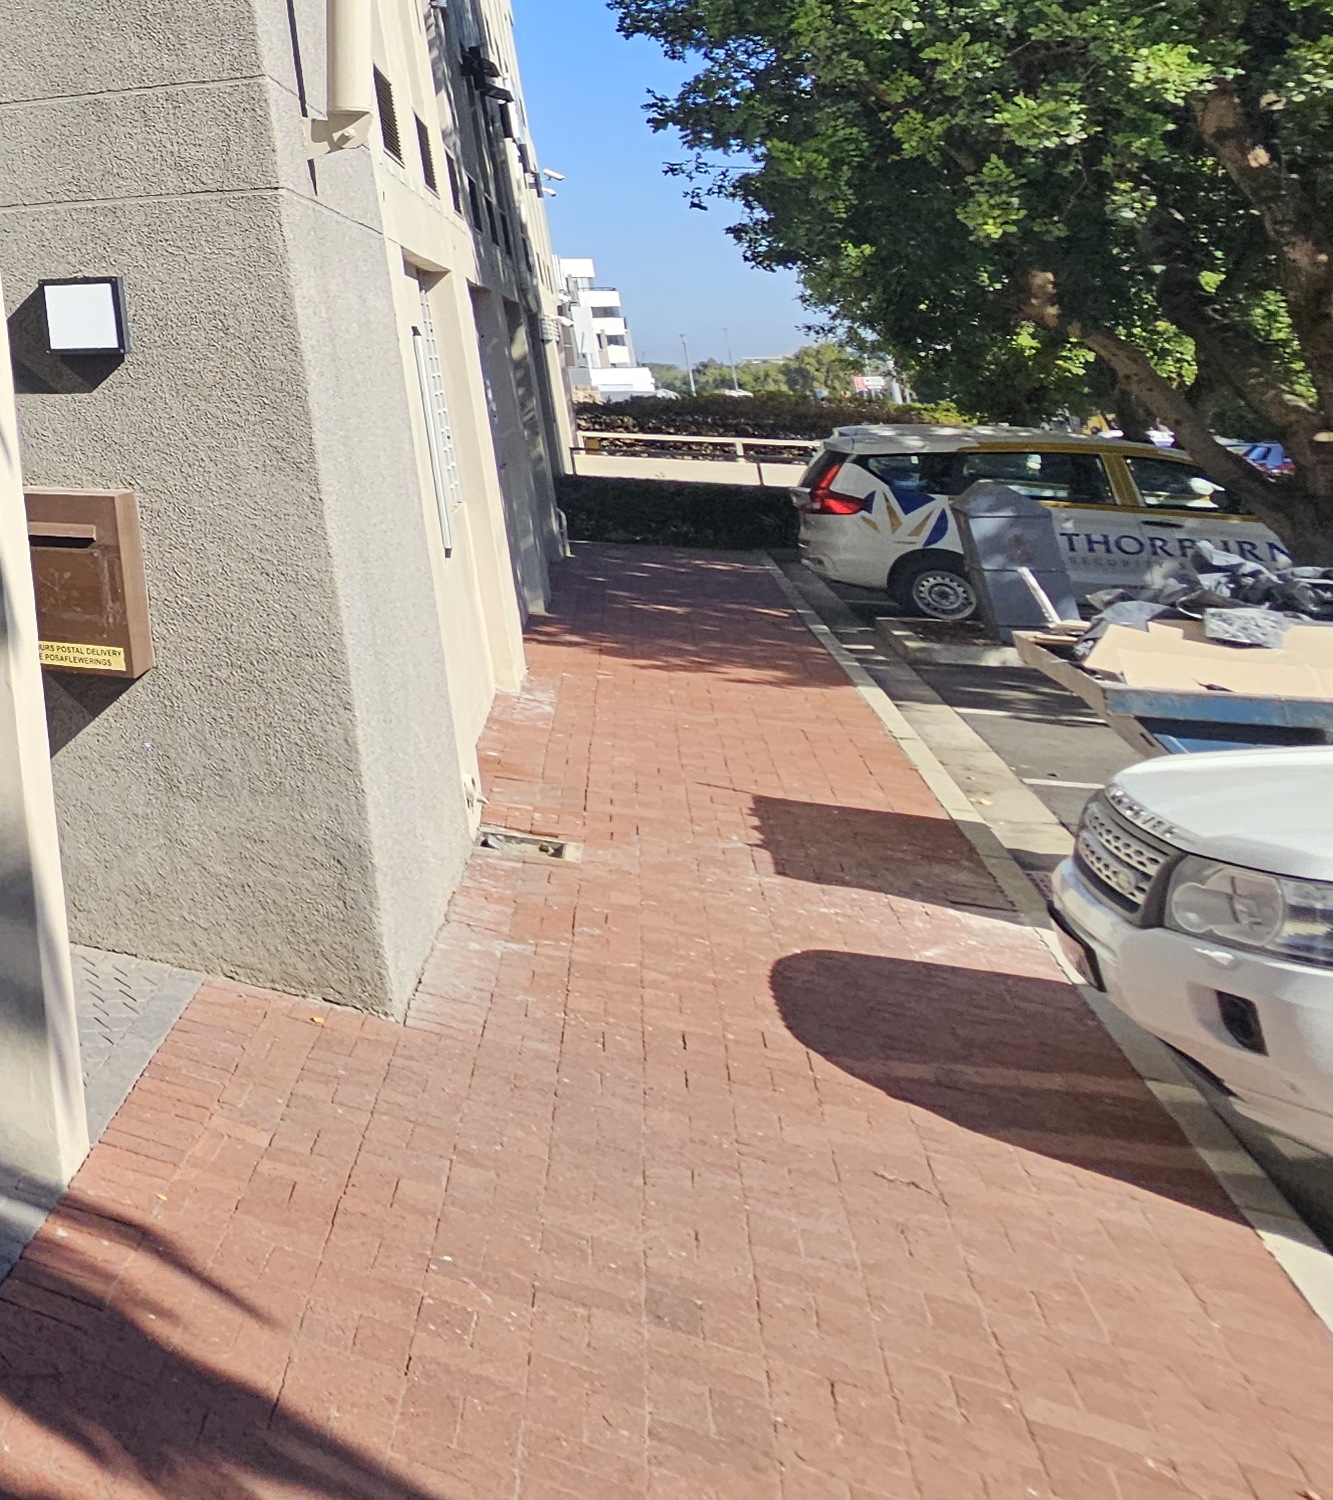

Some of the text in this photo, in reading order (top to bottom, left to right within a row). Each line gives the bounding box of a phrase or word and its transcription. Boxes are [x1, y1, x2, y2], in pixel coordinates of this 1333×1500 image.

[38, 644, 122, 657] URS POSTAL DELIVERY
